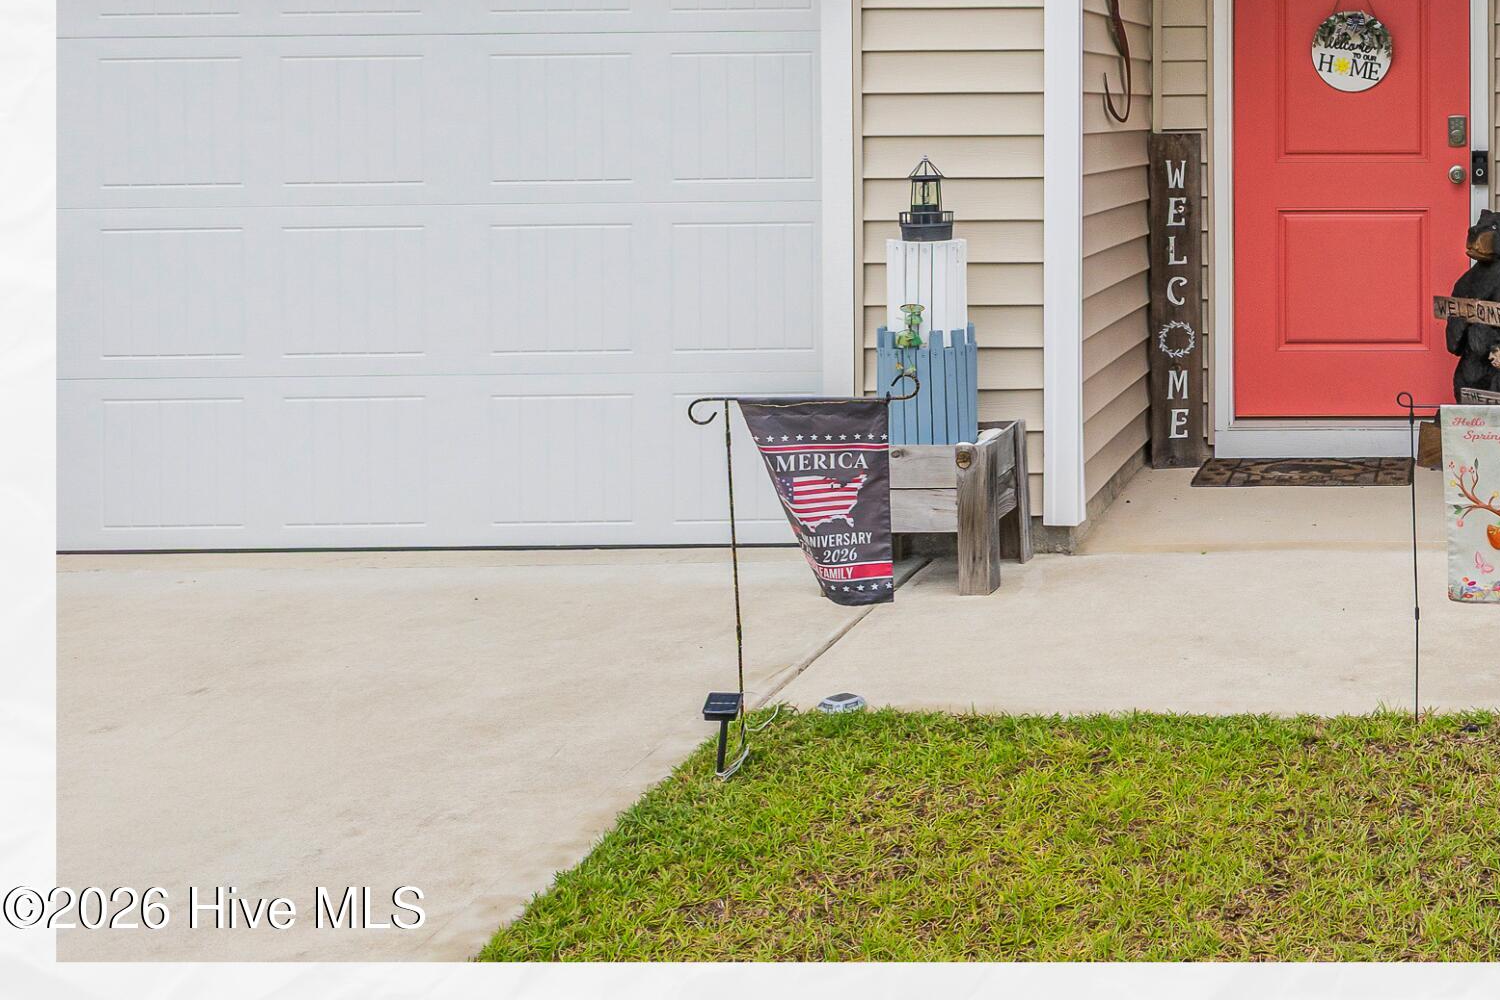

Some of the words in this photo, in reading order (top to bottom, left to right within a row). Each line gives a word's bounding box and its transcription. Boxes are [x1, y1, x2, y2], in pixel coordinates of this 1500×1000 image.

[1452, 416, 1486, 427] Hello
[822, 547, 857, 563] 2026
[819, 566, 854, 579] FAMILY
